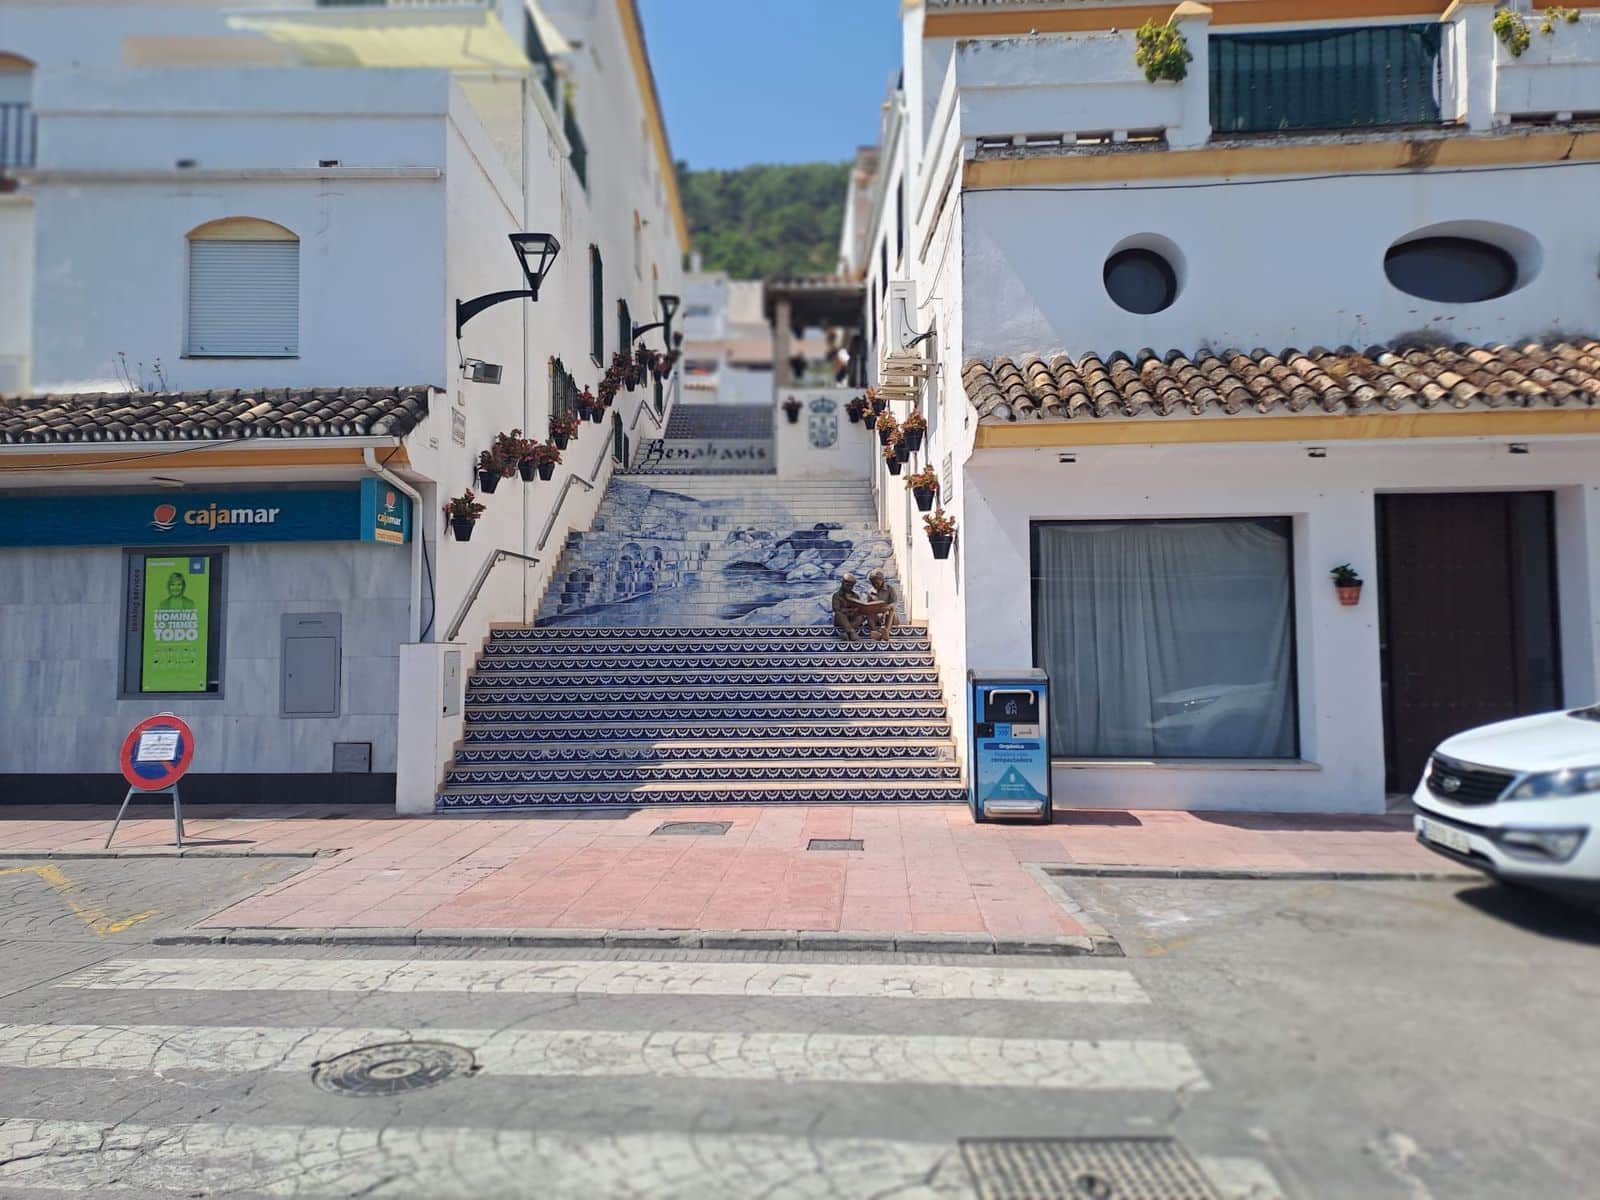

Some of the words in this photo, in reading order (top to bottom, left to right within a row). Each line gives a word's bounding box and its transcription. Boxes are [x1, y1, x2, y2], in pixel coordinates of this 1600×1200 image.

[184, 503, 280, 531] cajamar
[377, 512, 402, 526] cajamar
[168, 621, 198, 629] TIENES
[154, 629, 198, 641] TODO
